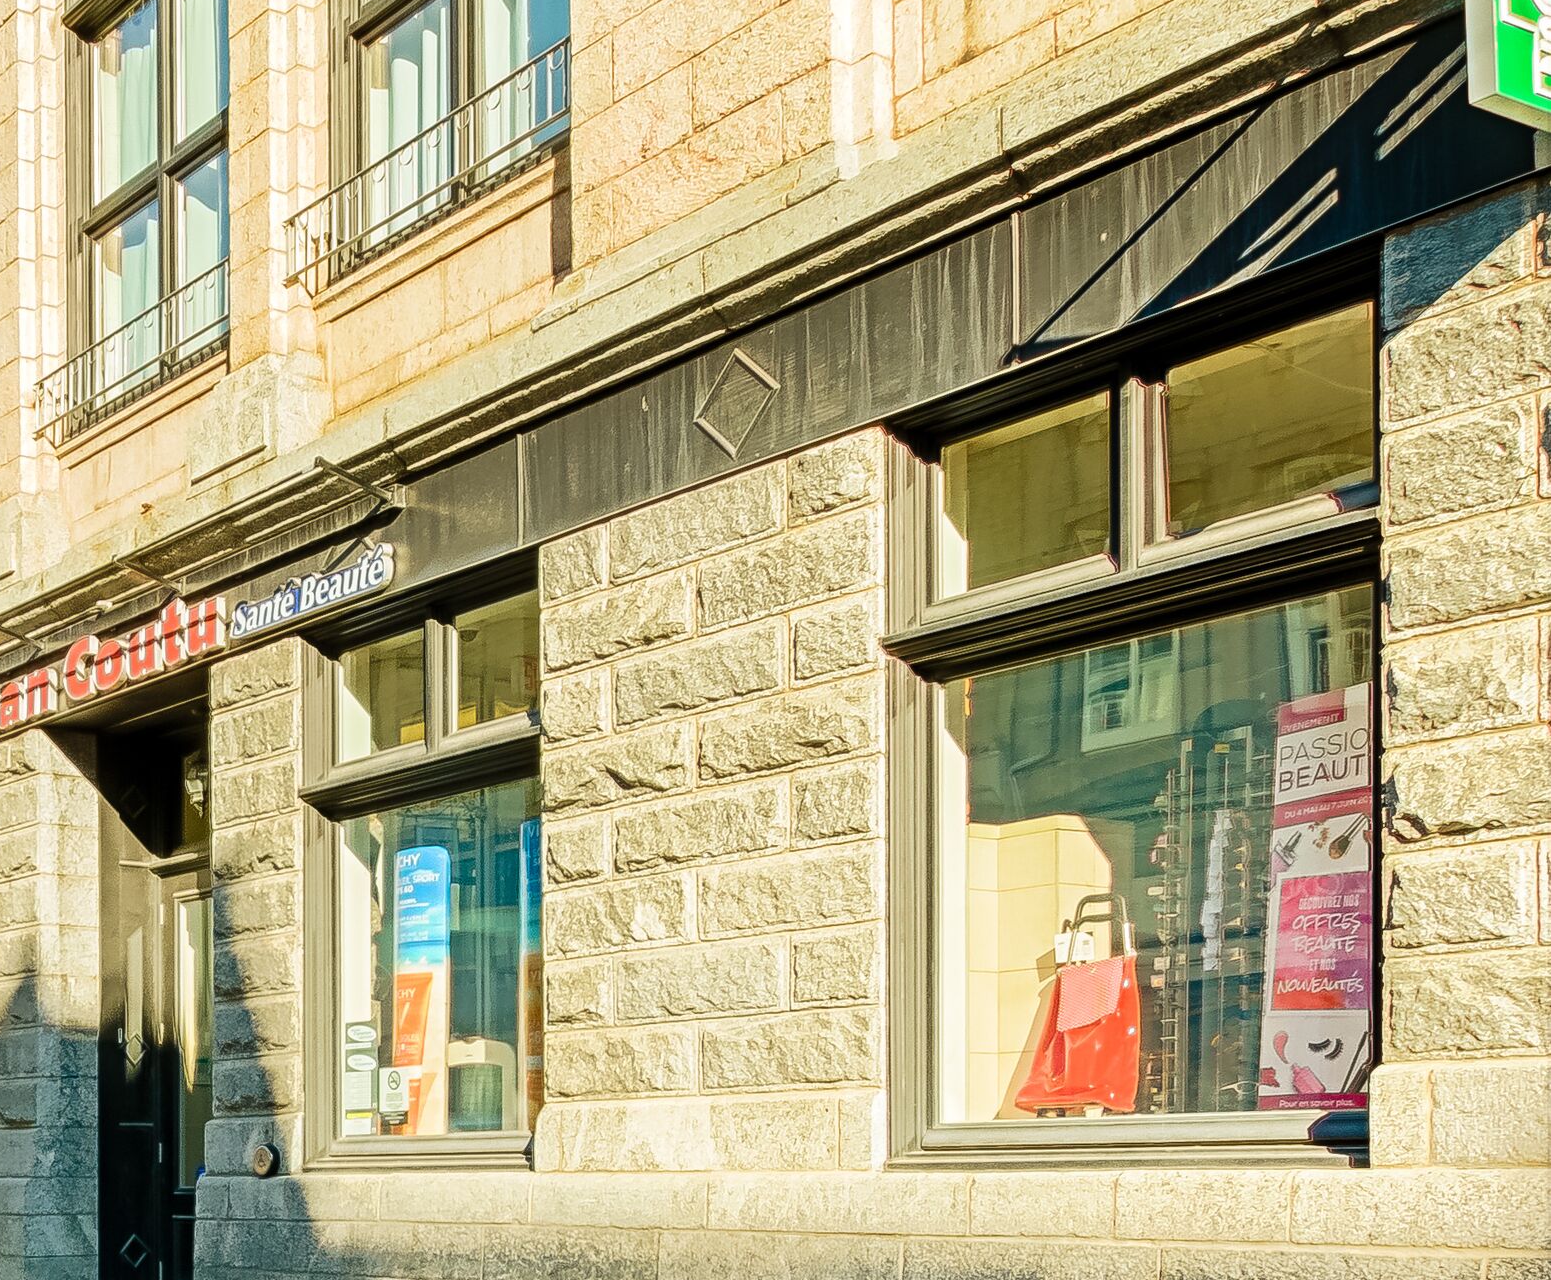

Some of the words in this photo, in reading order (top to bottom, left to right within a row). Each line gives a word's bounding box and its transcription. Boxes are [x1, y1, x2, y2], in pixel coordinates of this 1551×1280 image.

[233, 587, 297, 636] Santé
[298, 549, 388, 610] Beauté
[63, 595, 228, 701] Coutu
[1279, 753, 1366, 793] BEAUT
[1284, 811, 1296, 819] DU
[1303, 806, 1318, 815] MAI
[1342, 893, 1360, 908] NOS
[1292, 912, 1361, 931] OFFRES
[1309, 960, 1319, 971] ET
[1321, 959, 1337, 971] NOS
[1276, 970, 1365, 995] NOUVEAUTÉS
[1279, 1099, 1298, 1108] Pour
[1311, 1099, 1335, 1107] savoir
